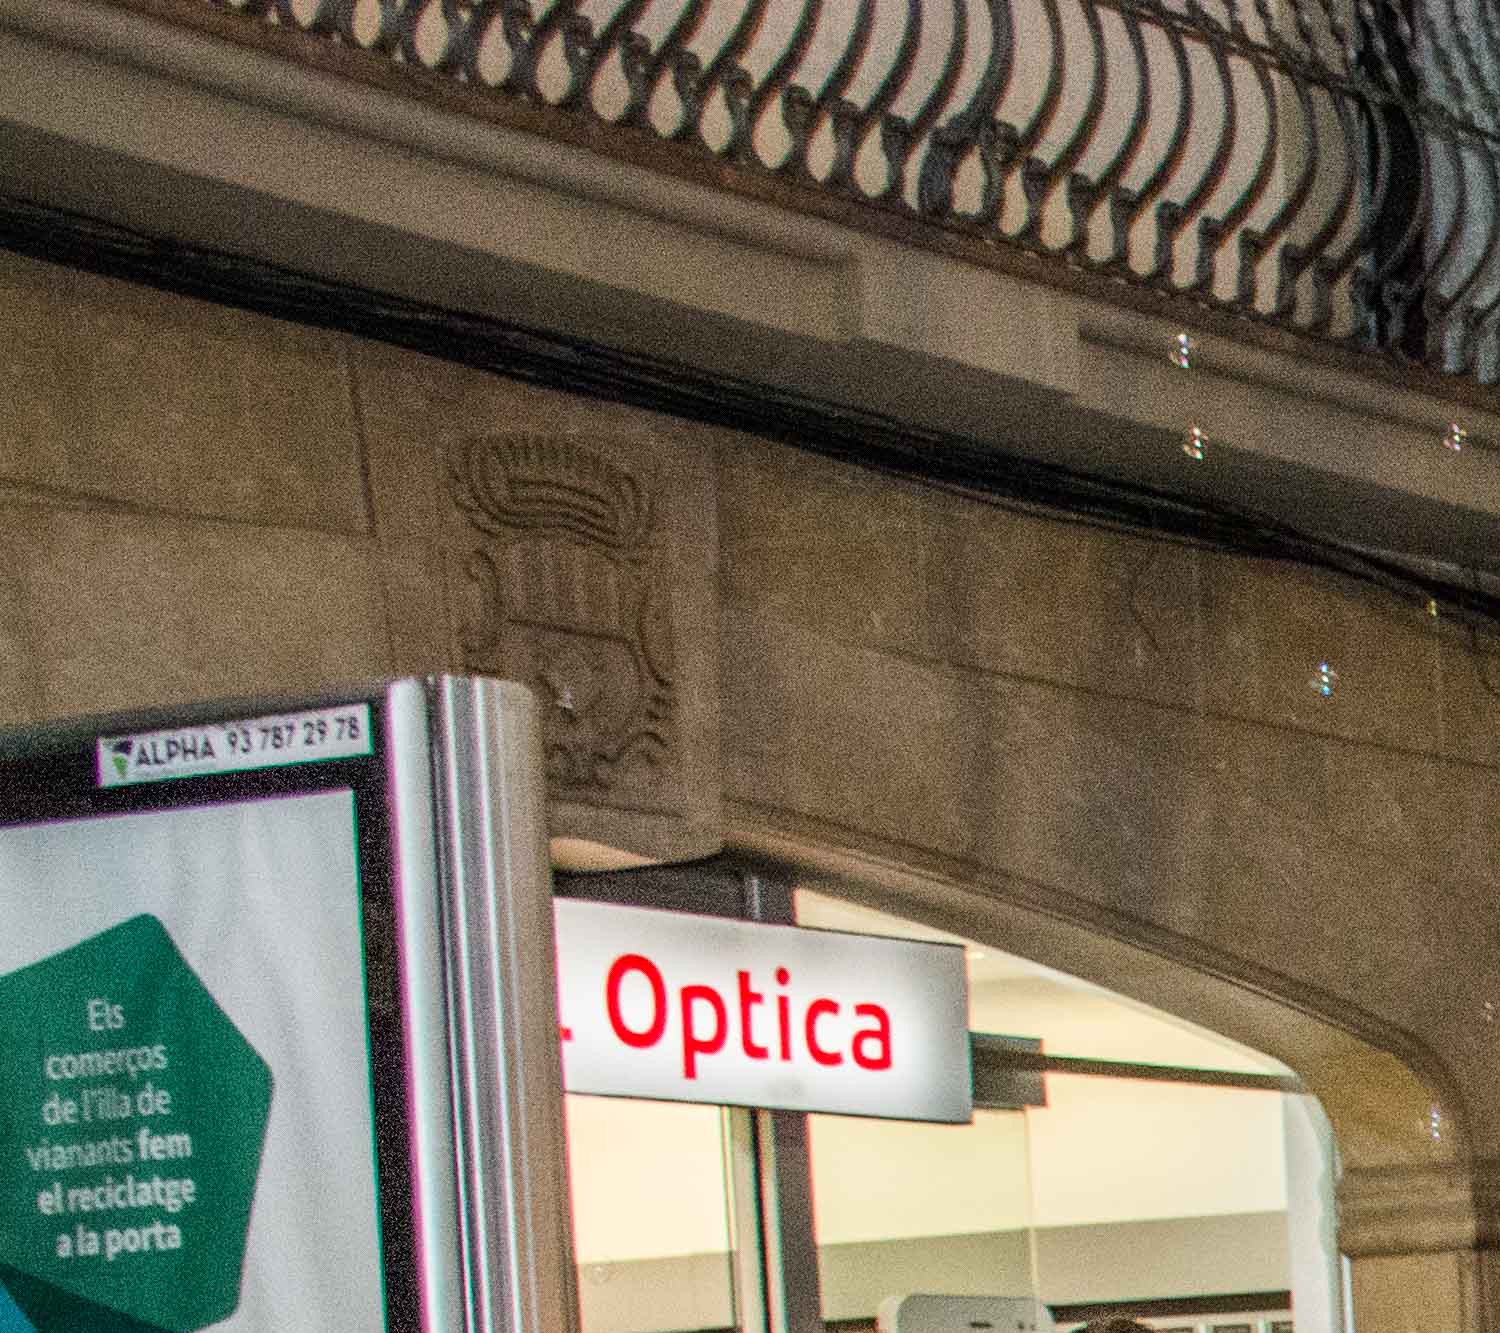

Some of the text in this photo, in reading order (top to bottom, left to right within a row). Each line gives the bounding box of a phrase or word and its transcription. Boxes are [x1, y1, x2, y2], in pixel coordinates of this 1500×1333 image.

[135, 715, 360, 767] ALPHA 93 787 29 78
[88, 998, 125, 1031] Els
[604, 952, 893, 1081] Optica
[44, 1044, 168, 1080] comerços
[41, 1092, 78, 1126] de
[136, 1082, 173, 1117] de
[25, 1126, 193, 1171] vianants fem
[37, 1174, 196, 1215] el reciclatge
[56, 1219, 182, 1261] a la porta
